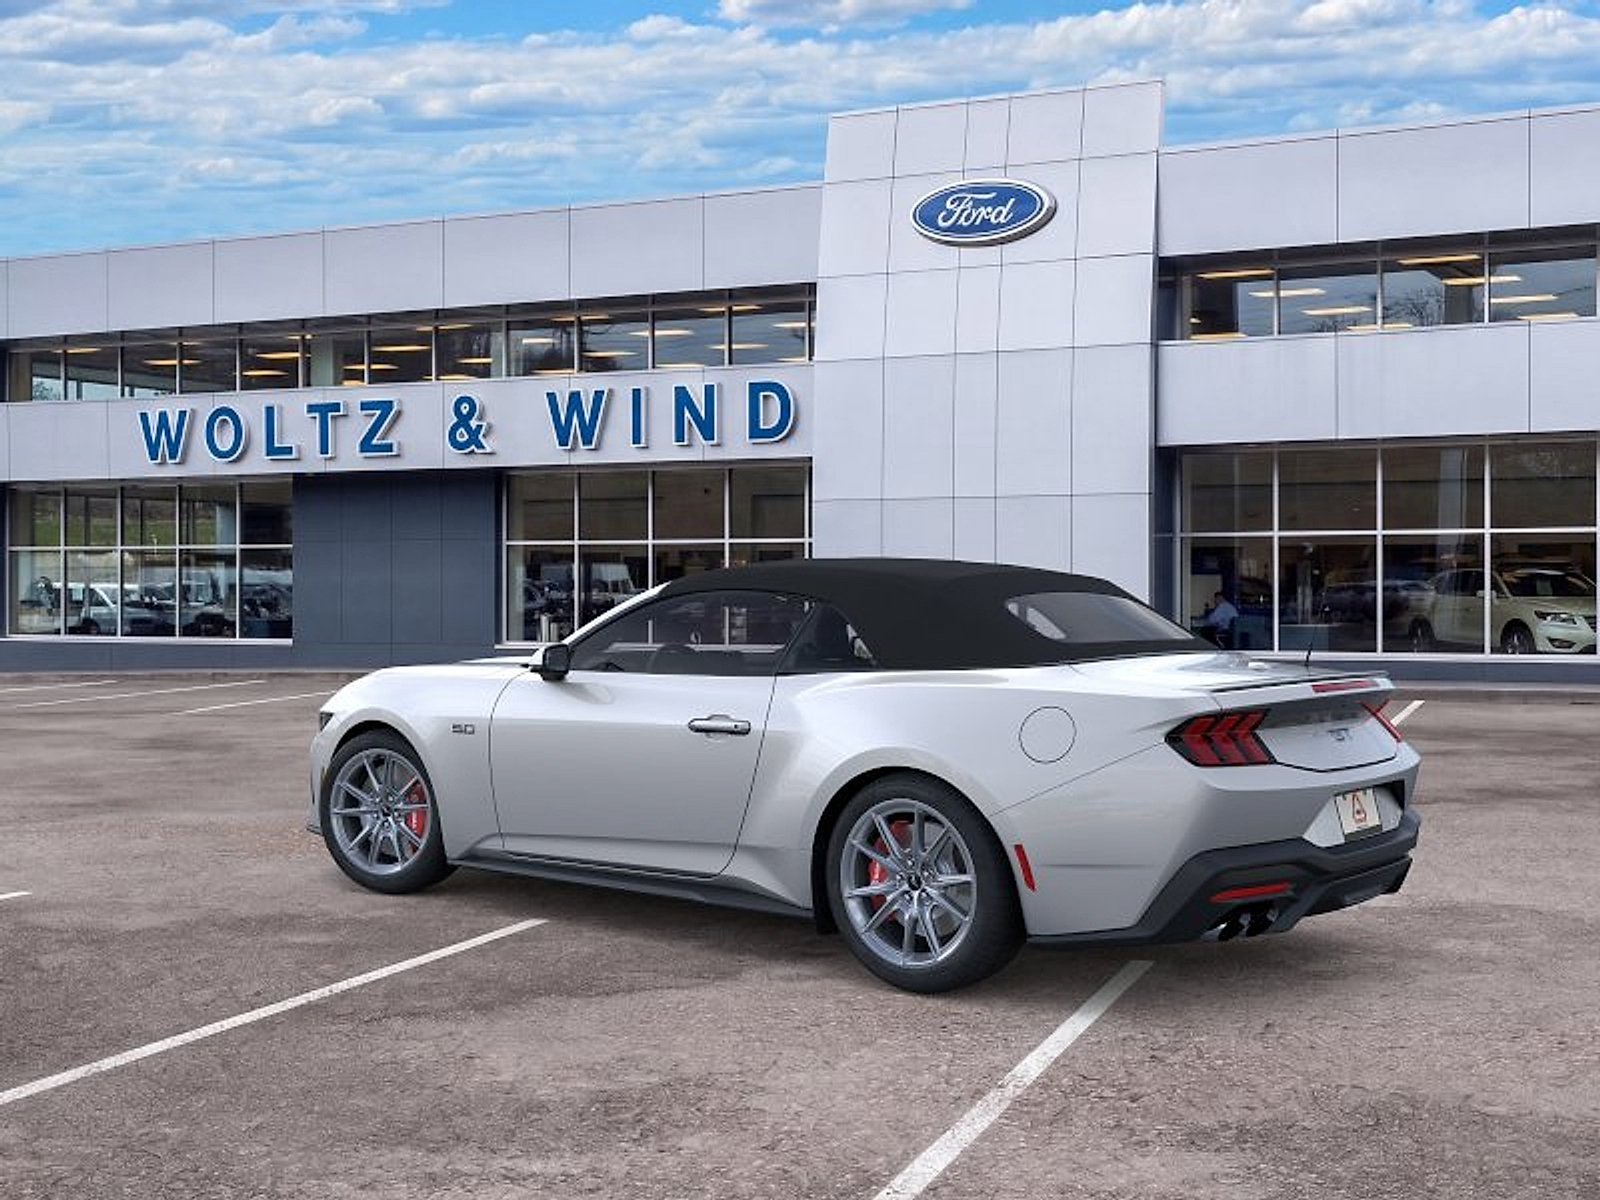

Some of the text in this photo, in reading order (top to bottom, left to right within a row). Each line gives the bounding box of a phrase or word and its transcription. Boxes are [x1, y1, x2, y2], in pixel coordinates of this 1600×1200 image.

[937, 192, 1015, 227] Ford
[139, 381, 795, 463] WOLTZ & WIND
